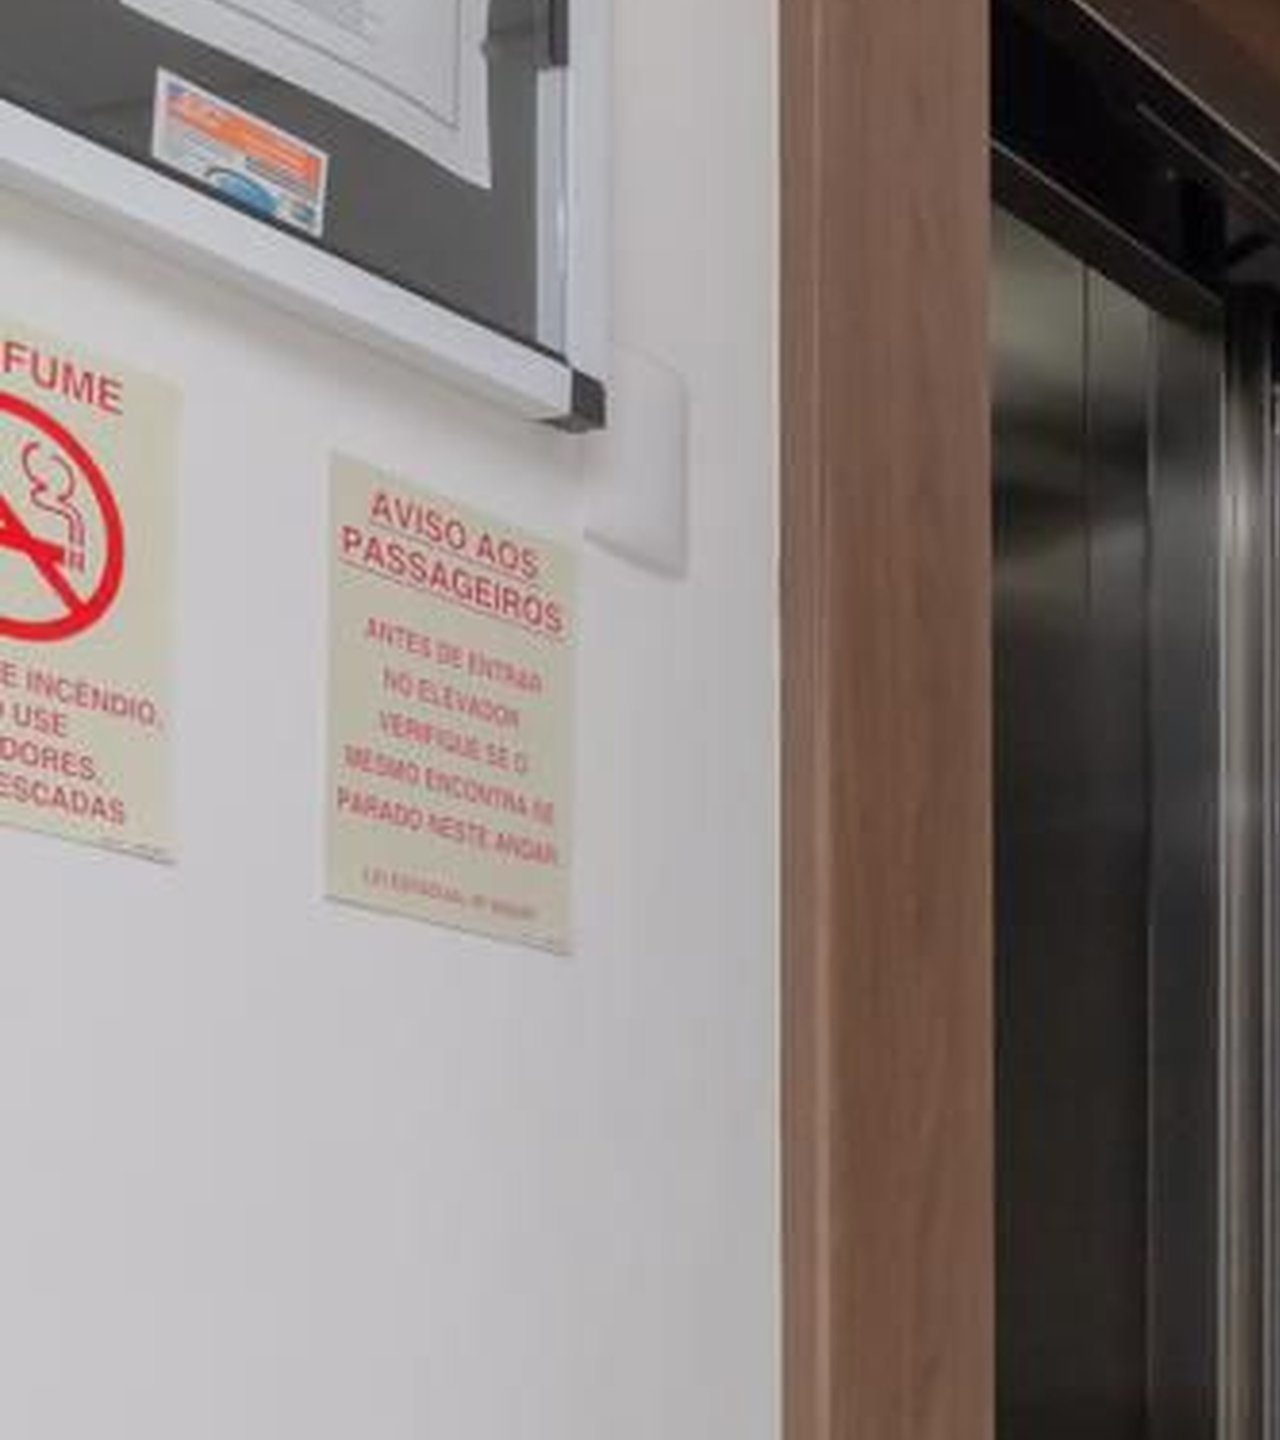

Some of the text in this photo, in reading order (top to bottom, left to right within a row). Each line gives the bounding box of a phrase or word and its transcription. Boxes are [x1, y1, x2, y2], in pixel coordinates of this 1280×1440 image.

[4, 340, 123, 416] FUME
[369, 492, 539, 580] AVISO AOS
[341, 525, 563, 634] PASSAGEIROS
[365, 616, 543, 694] ANTES DE ENTRAR
[13, 702, 68, 738] USE
[382, 666, 520, 728] NO ELEVADOR
[379, 710, 482, 761] VERIFIQUE
[486, 742, 510, 772] SE
[344, 744, 421, 786] MESMO
[425, 766, 528, 816] ENCONTRA
[337, 785, 424, 832] PARADO
[427, 812, 489, 851] NESTE
